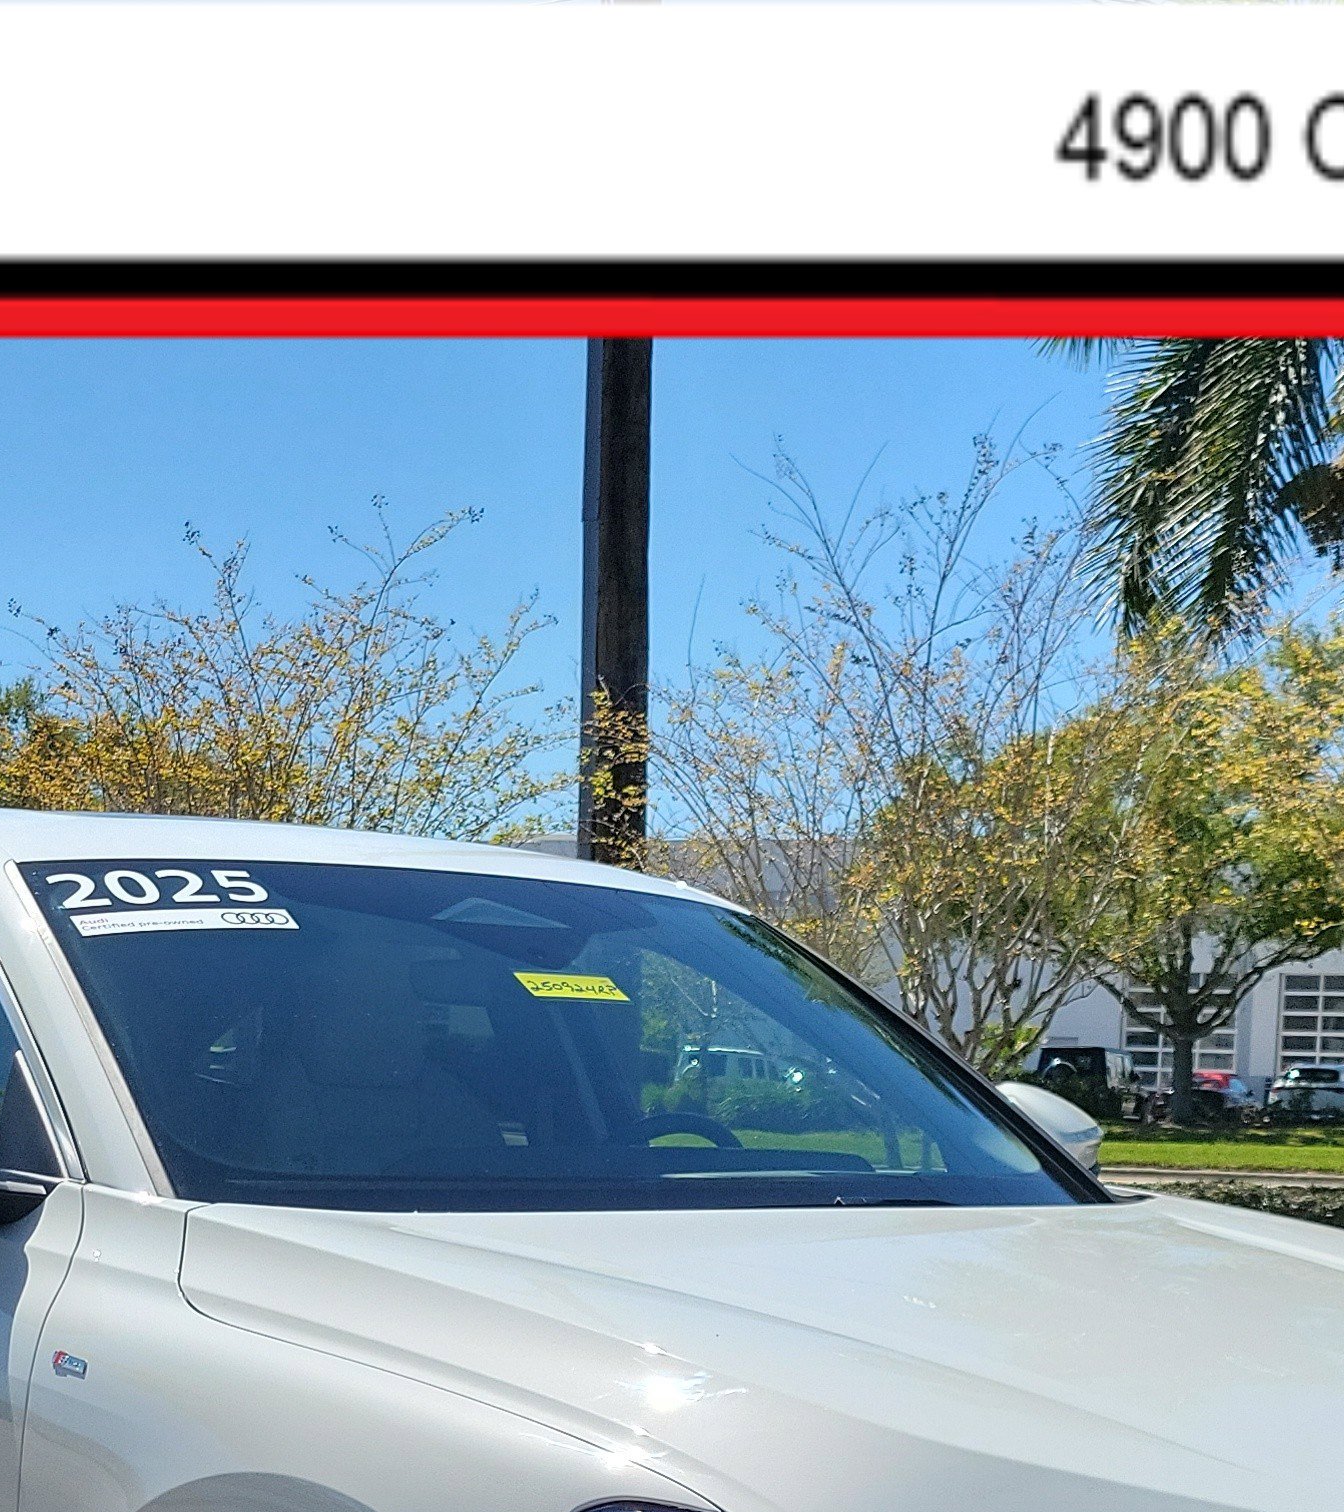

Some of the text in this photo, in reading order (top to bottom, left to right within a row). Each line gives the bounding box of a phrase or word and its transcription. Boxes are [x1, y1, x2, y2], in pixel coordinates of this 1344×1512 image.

[45, 869, 269, 909] 2025
[79, 917, 109, 926] Audi
[82, 921, 135, 932] Certified
